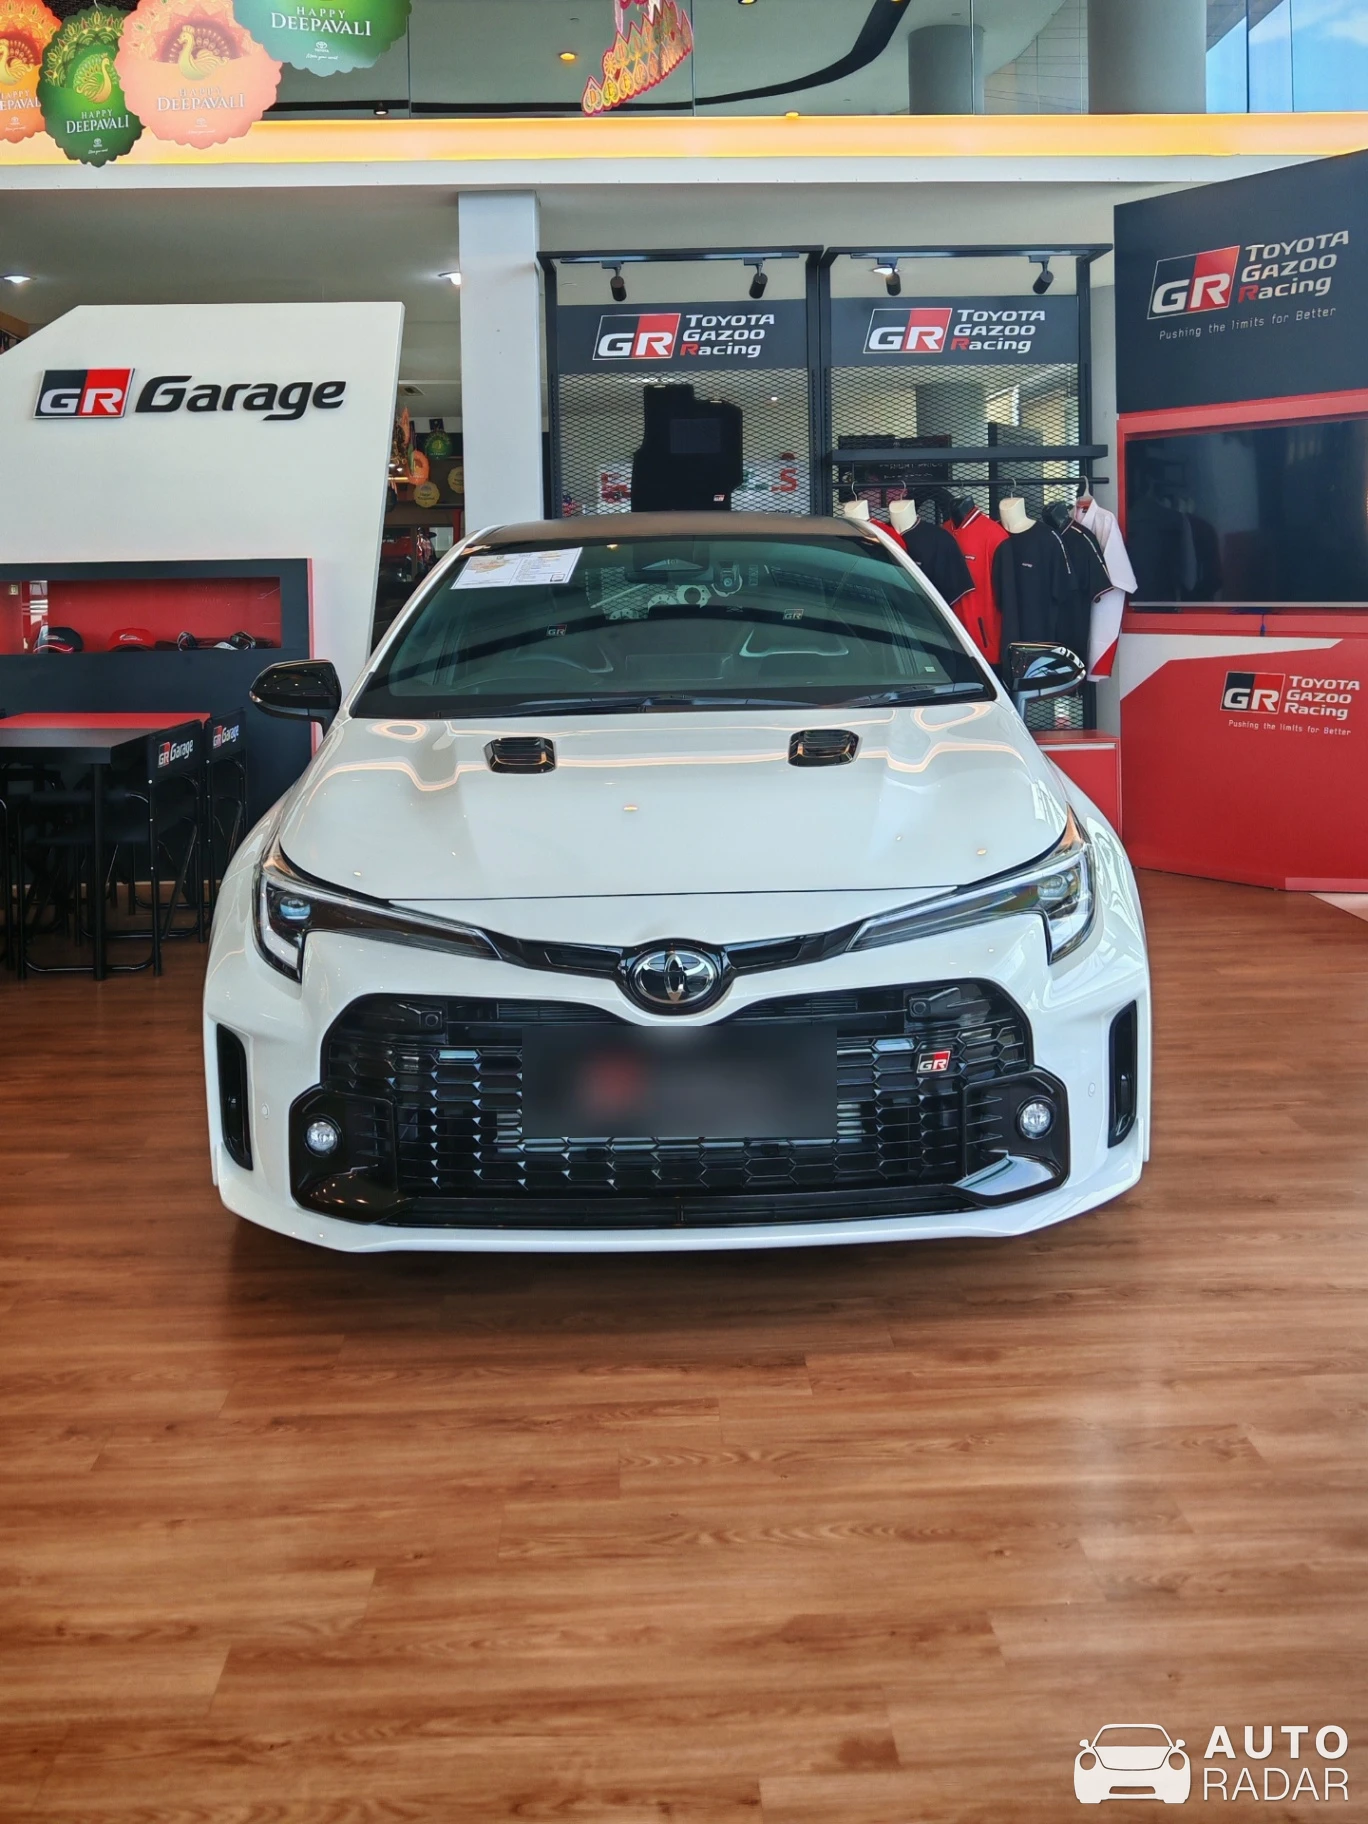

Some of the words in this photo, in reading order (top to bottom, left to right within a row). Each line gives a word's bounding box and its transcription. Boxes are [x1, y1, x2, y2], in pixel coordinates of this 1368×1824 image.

[296, 6, 346, 18] HAPPY
[271, 12, 371, 36] DEEPAVALI
[179, 87, 222, 97] HAPPY
[157, 93, 246, 111] DEEPAVALI
[81, 109, 113, 119] HAPPY
[66, 115, 129, 133] DEEPAVALI
[1245, 230, 1349, 262] TOYOTA
[1240, 253, 1337, 283] GAZOO
[1151, 273, 1231, 314] GR
[1238, 276, 1332, 303] Racing
[686, 314, 775, 327] TOYOTA
[957, 309, 1045, 322] TOYOTA
[1159, 327, 1202, 340] Pushing
[1208, 323, 1226, 333] the
[1231, 318, 1265, 330] limits
[1271, 313, 1289, 324] for
[1295, 307, 1337, 321] Better
[683, 329, 766, 342] GAZOO
[868, 326, 944, 350] GR
[953, 324, 1036, 336] GAZOO
[597, 332, 673, 357] GR
[680, 343, 761, 358] Racing
[950, 338, 1032, 354] Racing
[40, 387, 123, 414] GR
[135, 375, 347, 421] Garage
[1289, 675, 1360, 690] TOYOTA
[1223, 687, 1279, 712] GR
[1286, 689, 1352, 704] GAZOO
[1284, 703, 1348, 721] Racing
[213, 733, 222, 747] GR
[222, 725, 239, 743] Garage
[1228, 719, 1259, 730] Pushing
[1263, 722, 1276, 731] the
[1280, 723, 1303, 732] limits
[1307, 725, 1319, 734] for
[1323, 726, 1352, 736] Better
[158, 751, 169, 765] GR
[170, 739, 194, 762] Garage
[919, 1058, 948, 1071] GR
